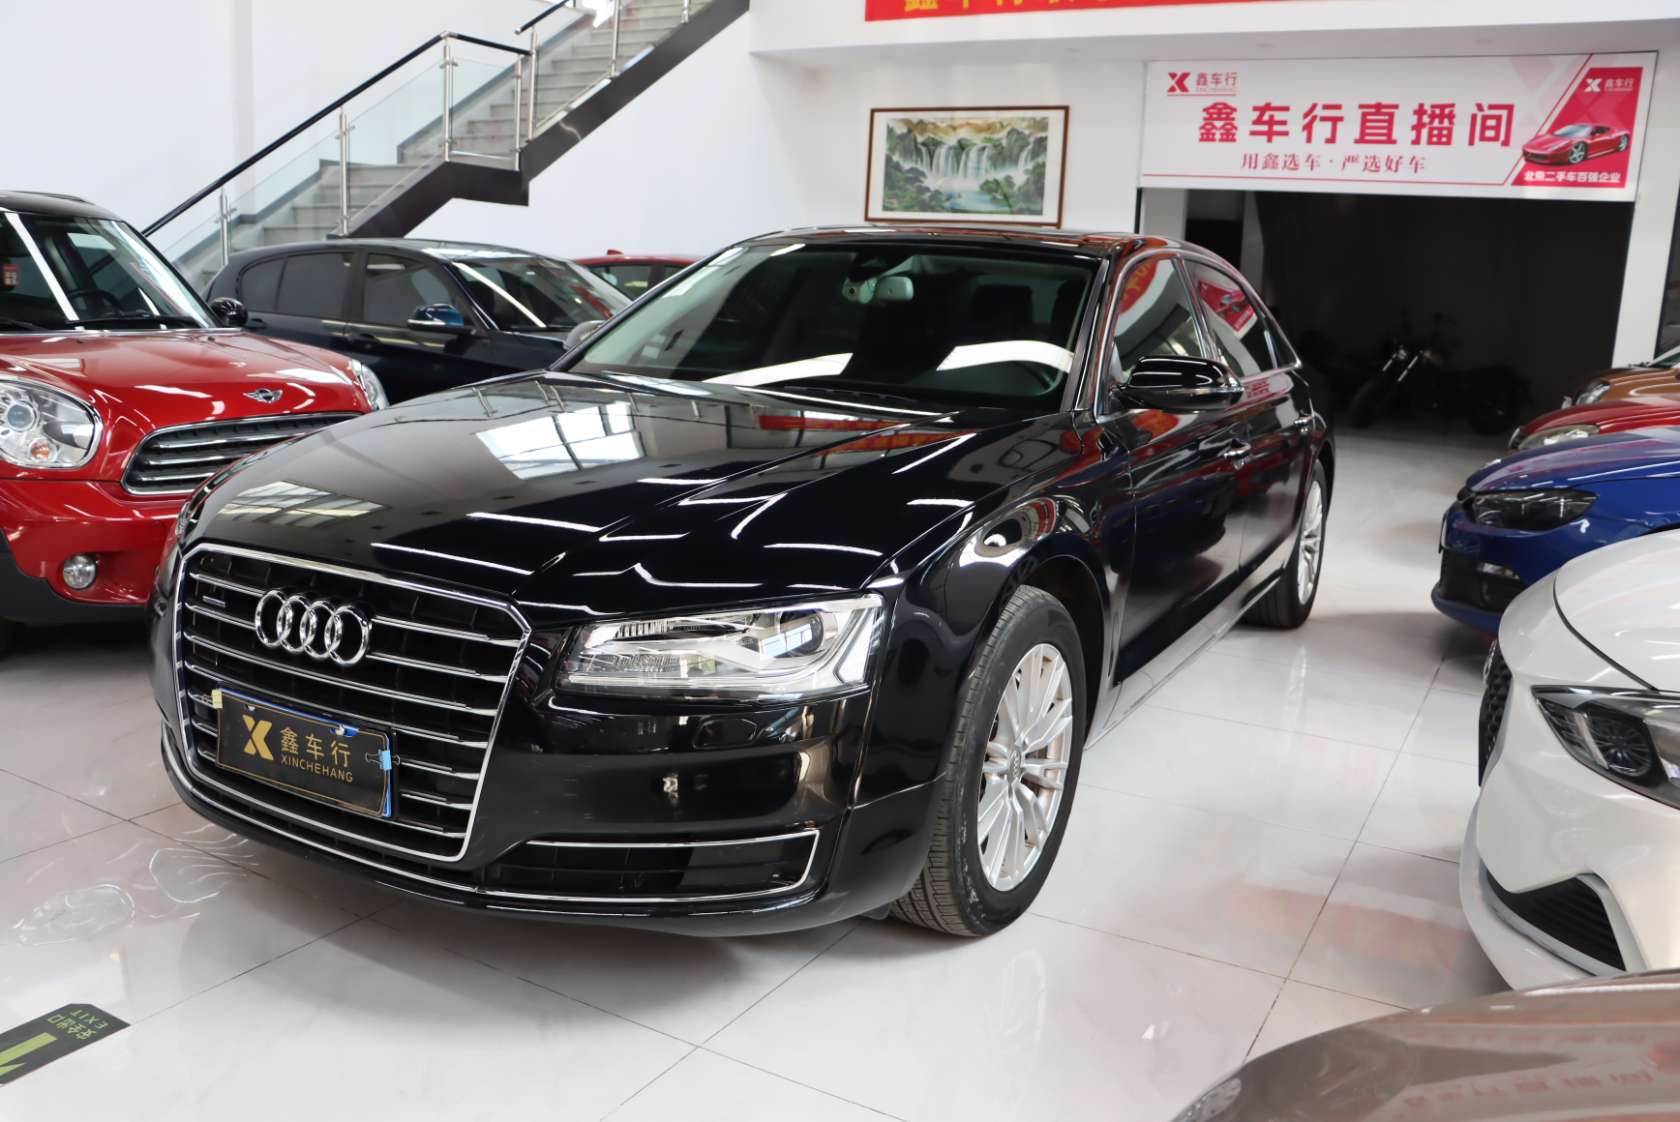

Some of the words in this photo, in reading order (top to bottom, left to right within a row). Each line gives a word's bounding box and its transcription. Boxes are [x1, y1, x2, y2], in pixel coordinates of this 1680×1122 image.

[1199, 102, 1515, 147] 鑫车行直播间
[280, 727, 351, 768] 鑫车行
[280, 753, 353, 783] XINCHEHANG
[69, 1009, 109, 1029] EXIT
